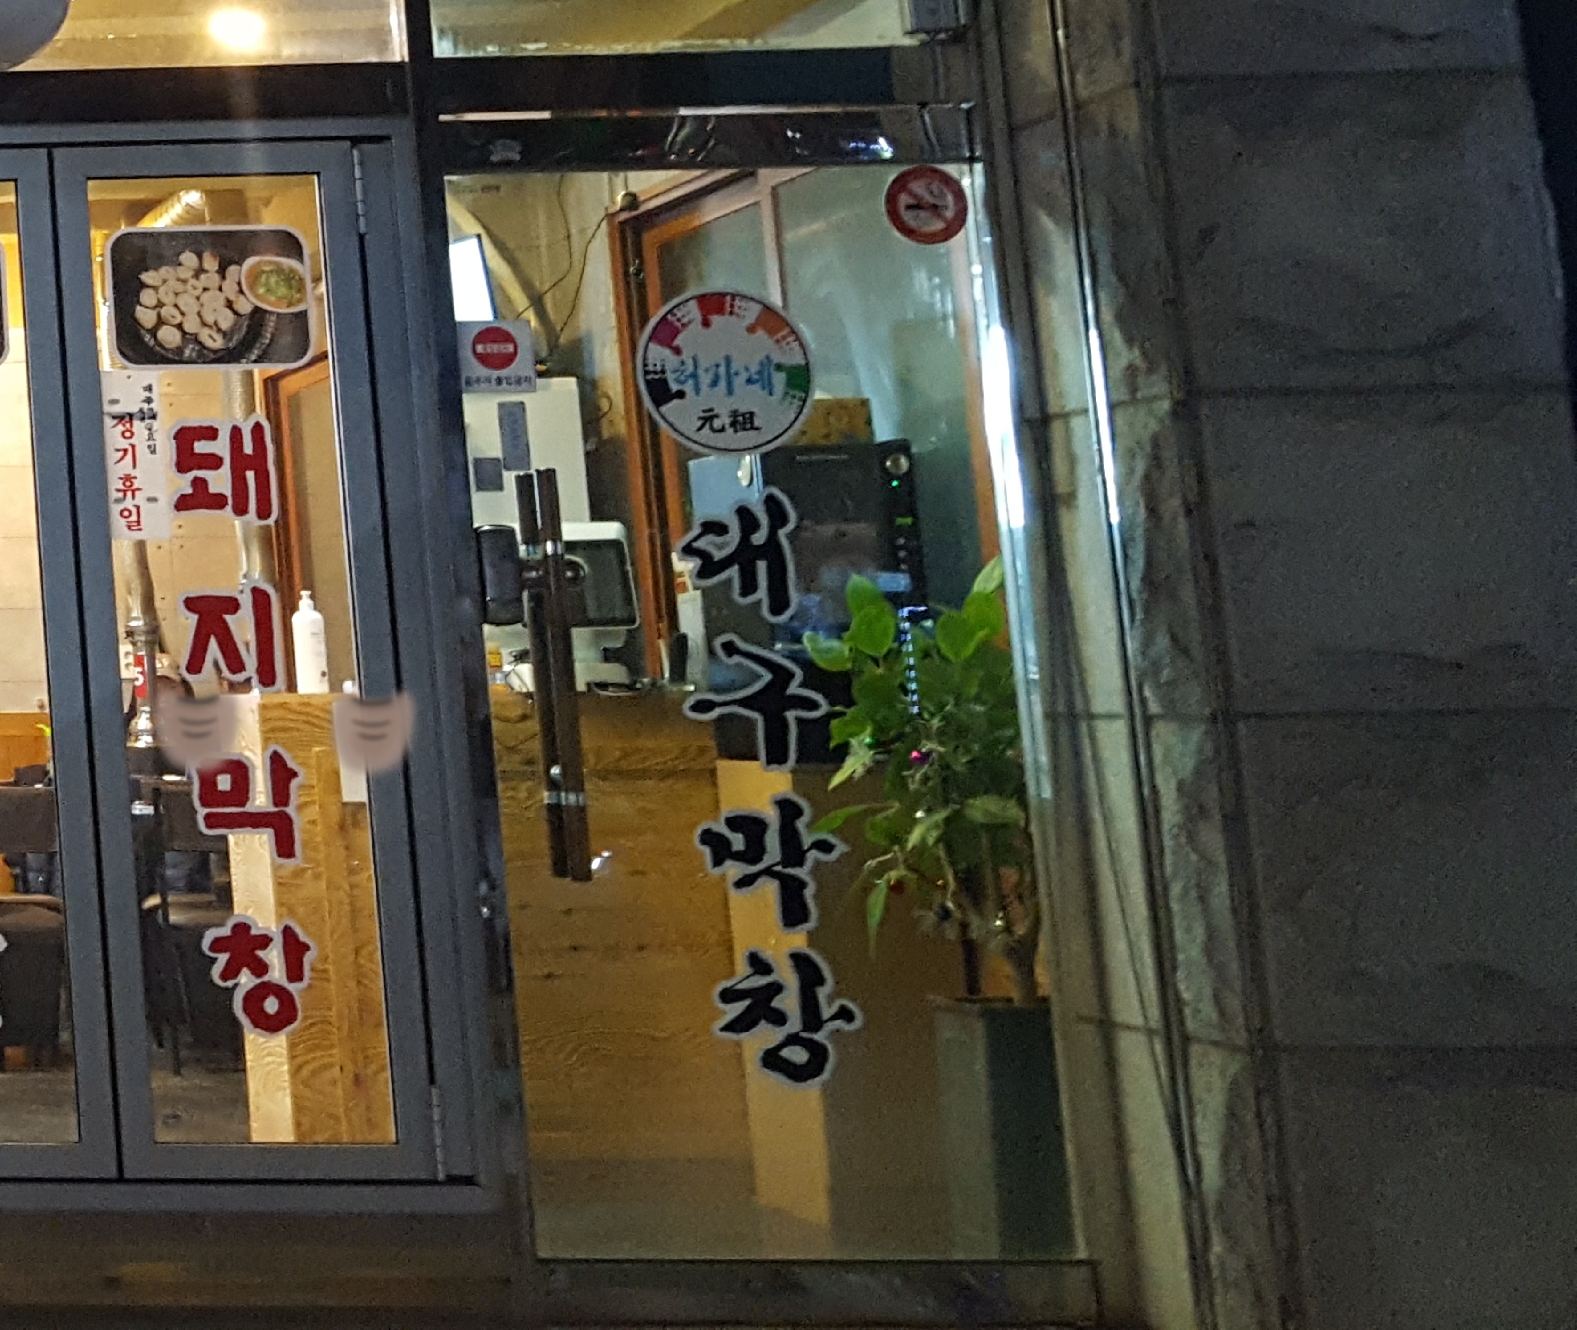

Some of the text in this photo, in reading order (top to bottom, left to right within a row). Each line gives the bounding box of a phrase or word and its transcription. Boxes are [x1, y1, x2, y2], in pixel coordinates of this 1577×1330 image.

[671, 353, 775, 397] 허가네
[696, 406, 763, 433] 元祖
[110, 413, 144, 532] 정기휴일
[170, 417, 317, 1037] 돼지막창
[678, 487, 863, 1090] 대구막창
